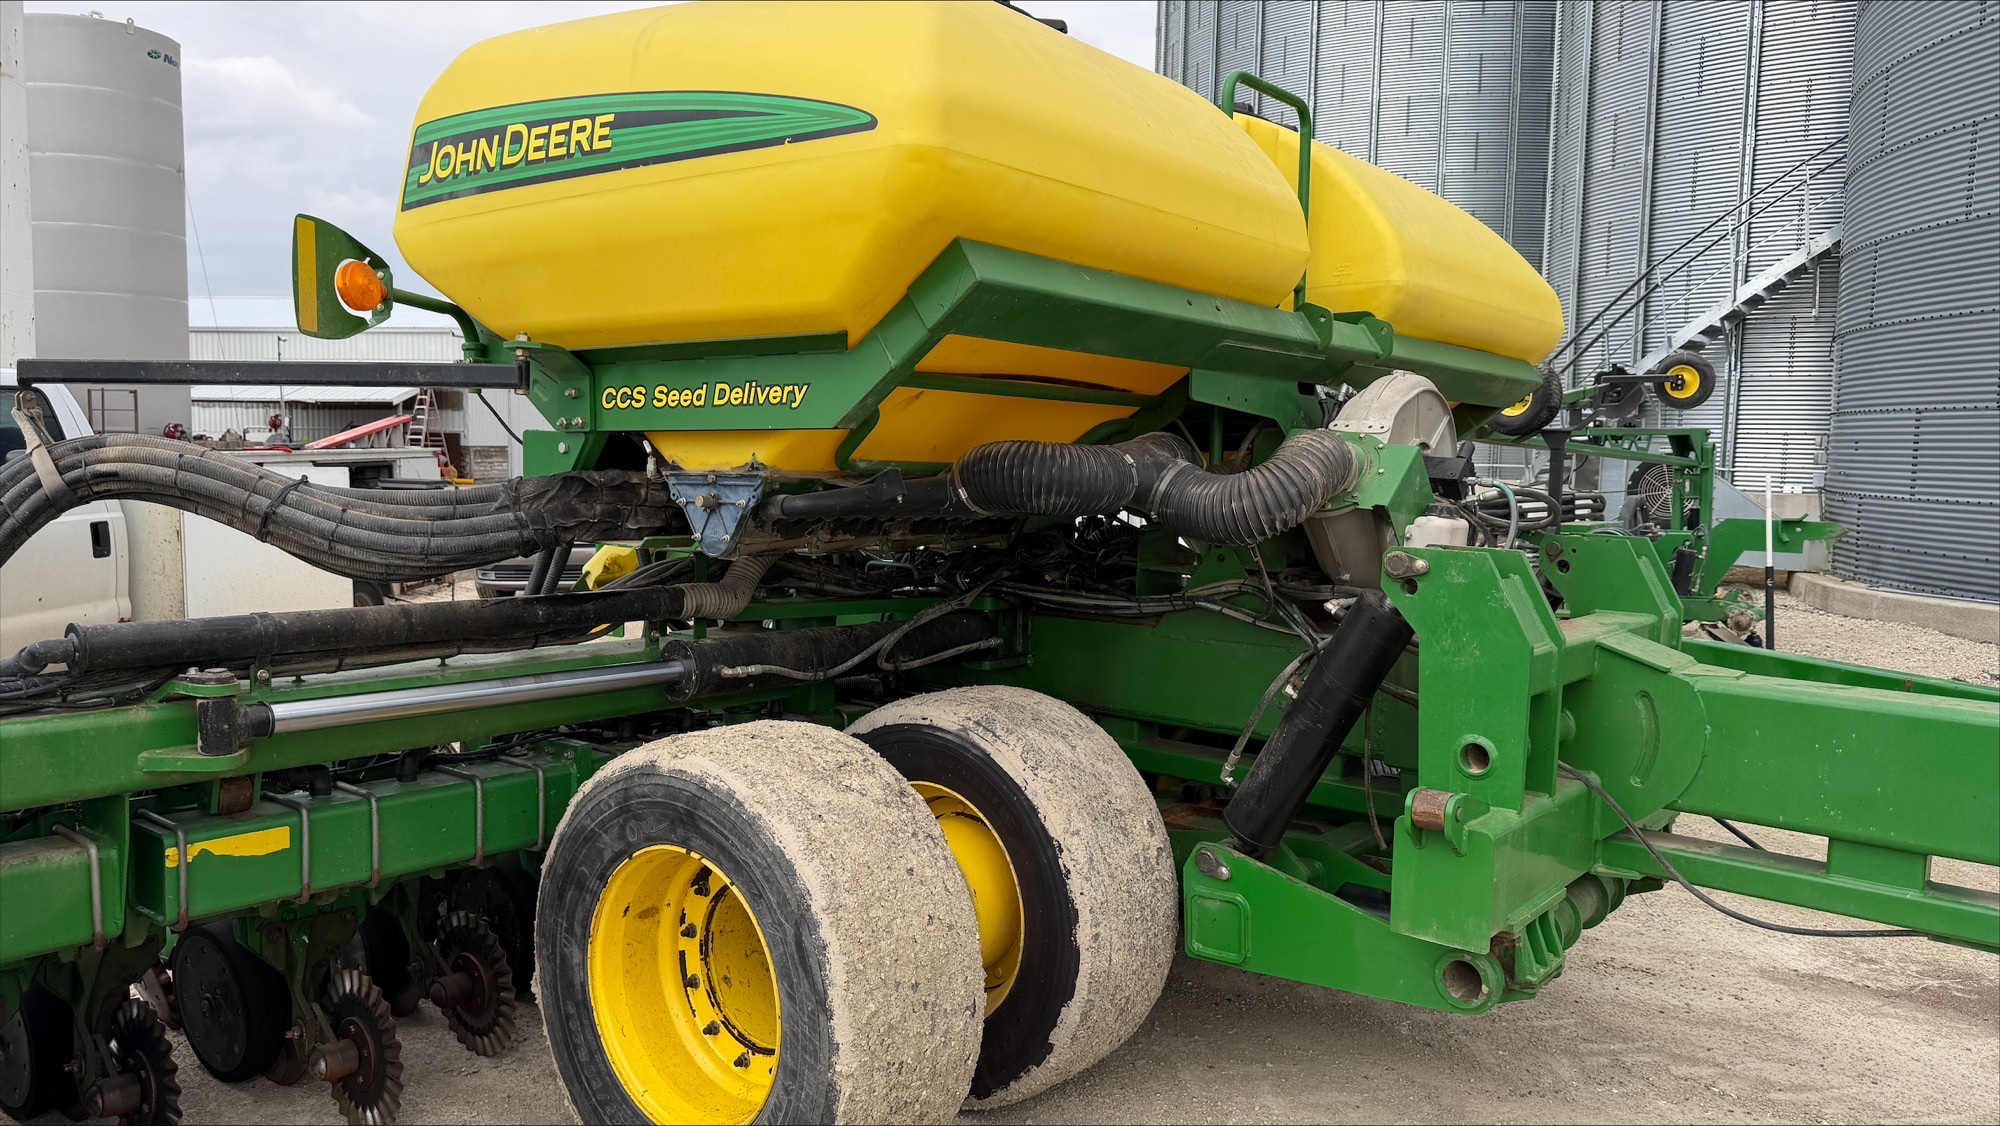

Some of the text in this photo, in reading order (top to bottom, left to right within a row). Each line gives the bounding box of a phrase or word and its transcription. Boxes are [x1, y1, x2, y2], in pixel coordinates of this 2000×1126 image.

[419, 113, 616, 185] JOHN DEERE
[601, 379, 809, 410] CCS Seed Delivery
